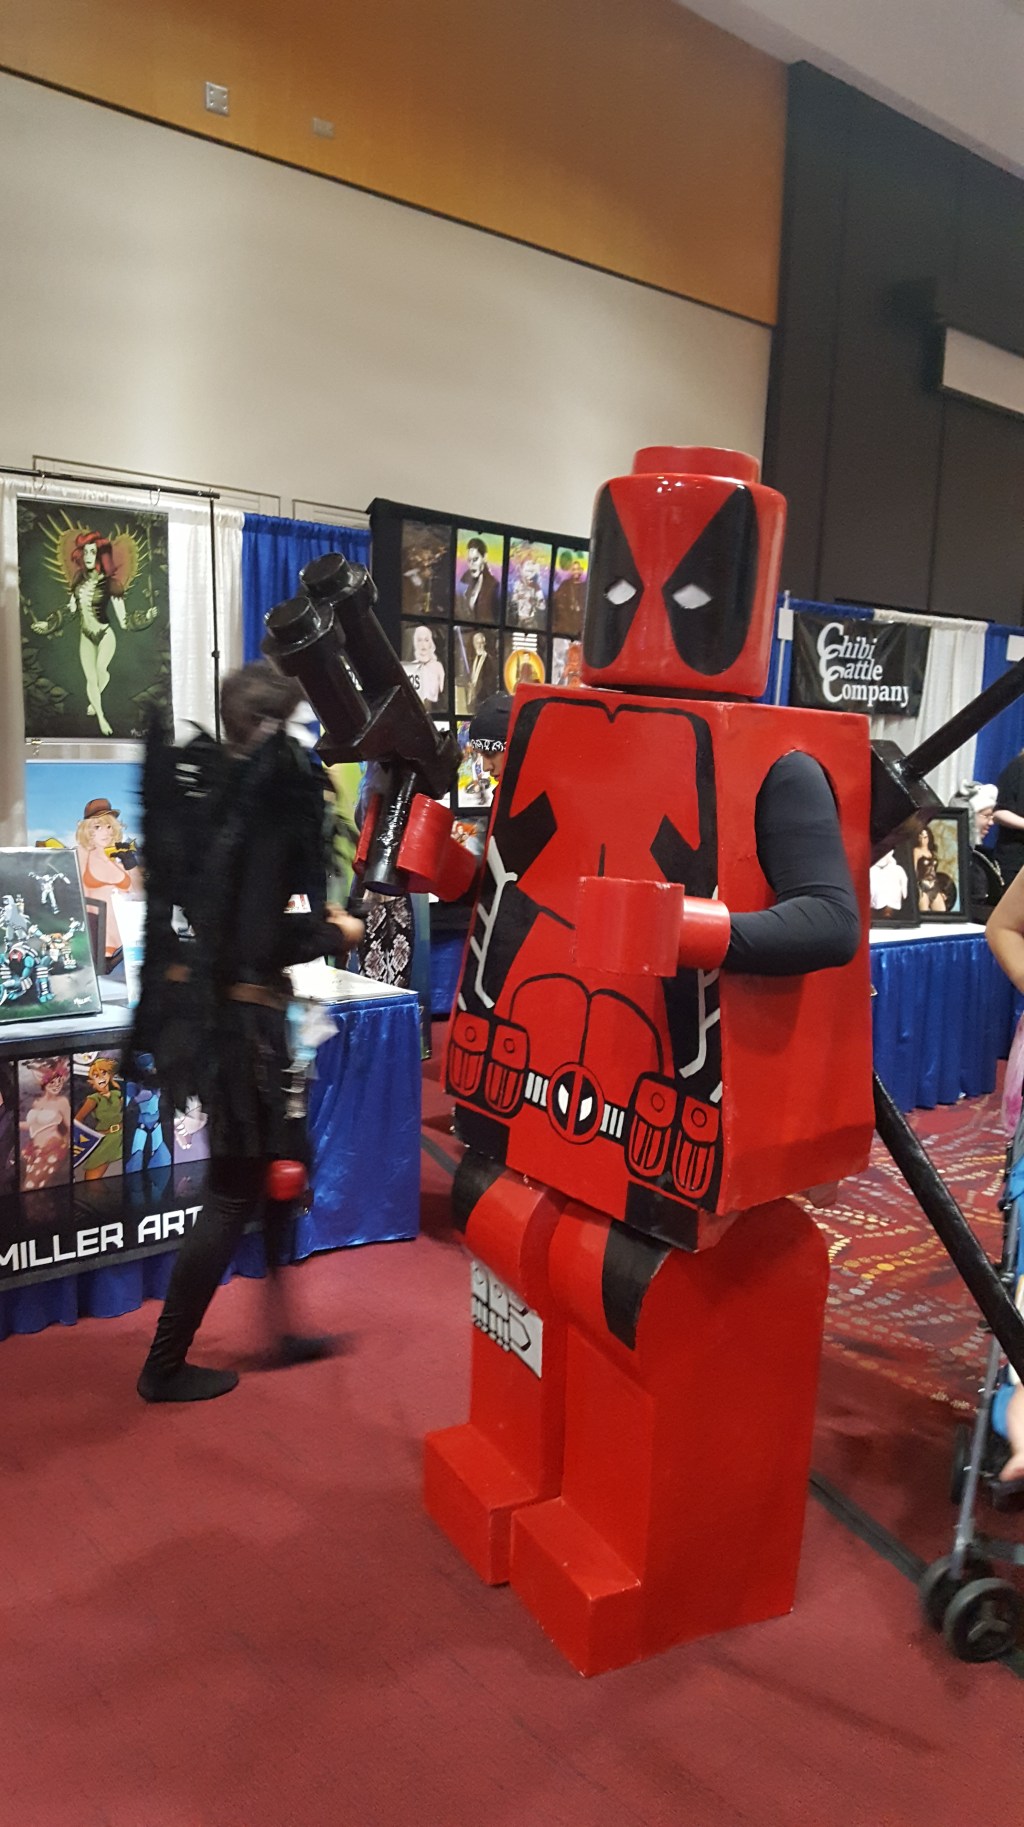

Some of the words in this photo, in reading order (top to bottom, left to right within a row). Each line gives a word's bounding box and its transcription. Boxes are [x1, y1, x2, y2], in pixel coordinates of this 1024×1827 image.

[817, 622, 877, 660] Chibi
[819, 644, 883, 681] Cattle
[822, 665, 909, 708] Company
[0, 1222, 124, 1271] MILLER
[138, 1205, 203, 1244] ART
